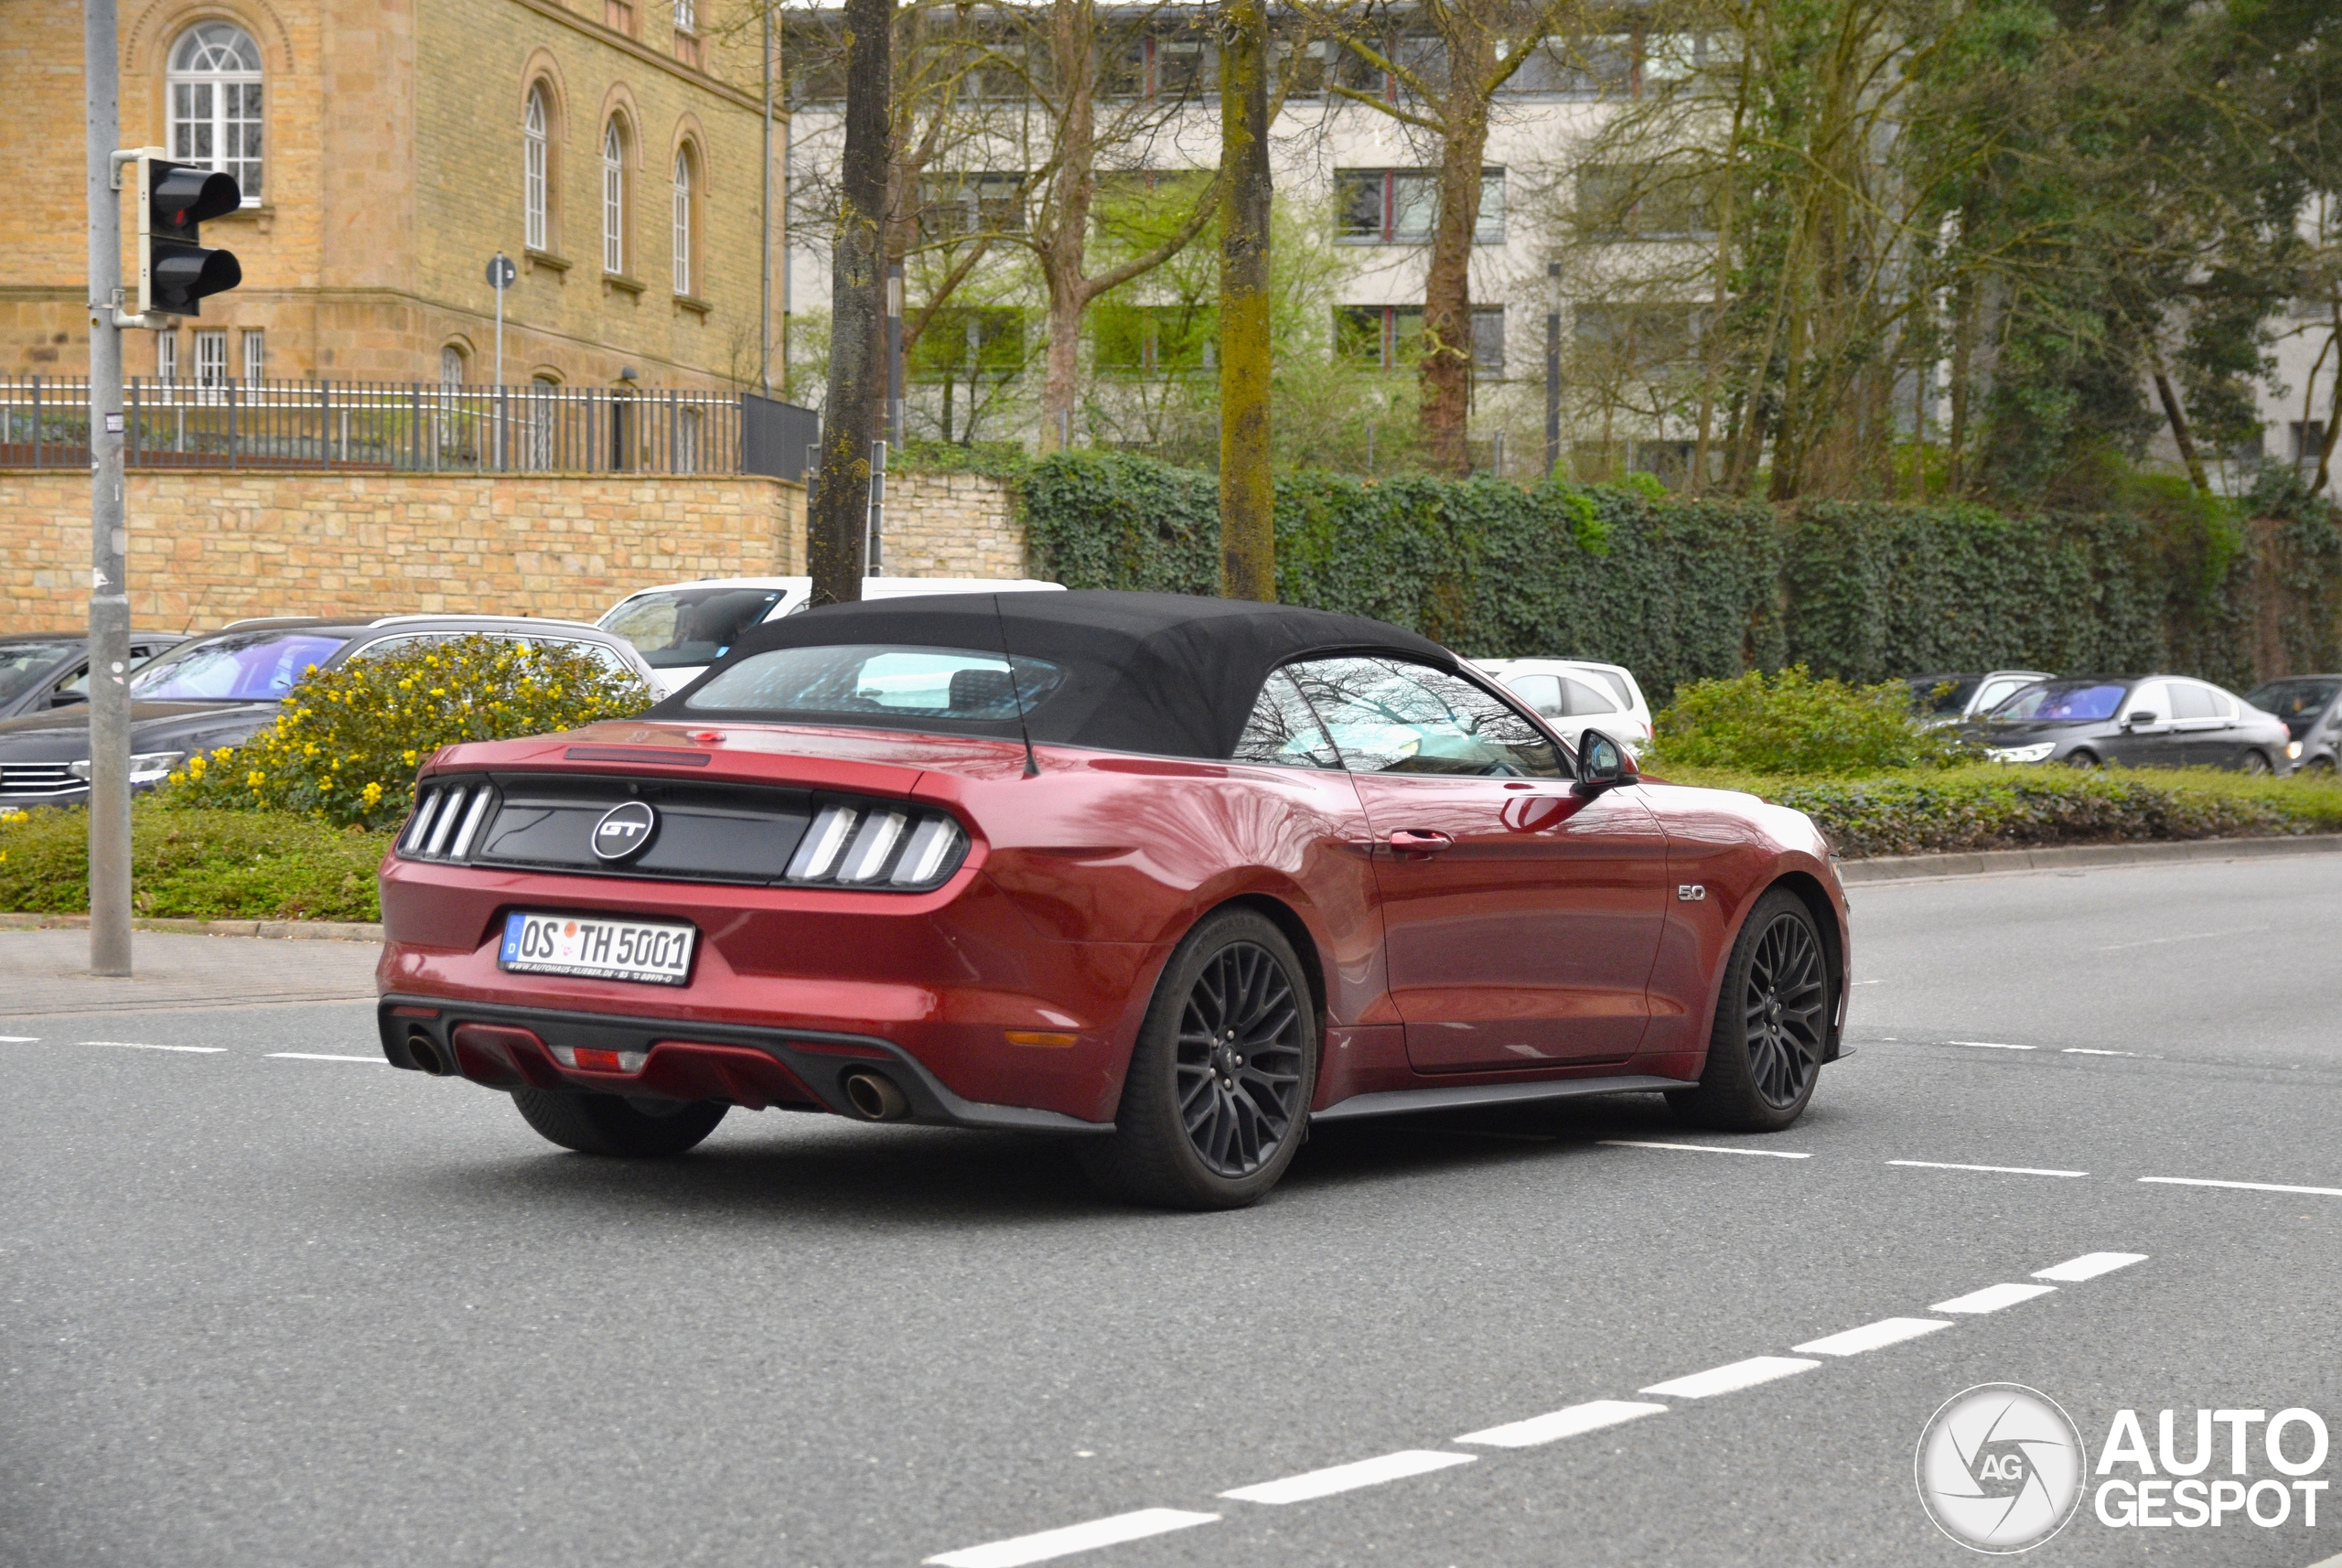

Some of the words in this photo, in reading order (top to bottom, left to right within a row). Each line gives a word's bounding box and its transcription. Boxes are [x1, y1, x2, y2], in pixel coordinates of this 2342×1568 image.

[599, 822, 646, 836] GT
[1678, 885, 1706, 901] 5.0
[508, 943, 516, 954] D
[521, 919, 559, 959] OS
[580, 925, 615, 963] TH
[617, 929, 688, 970] 5001
